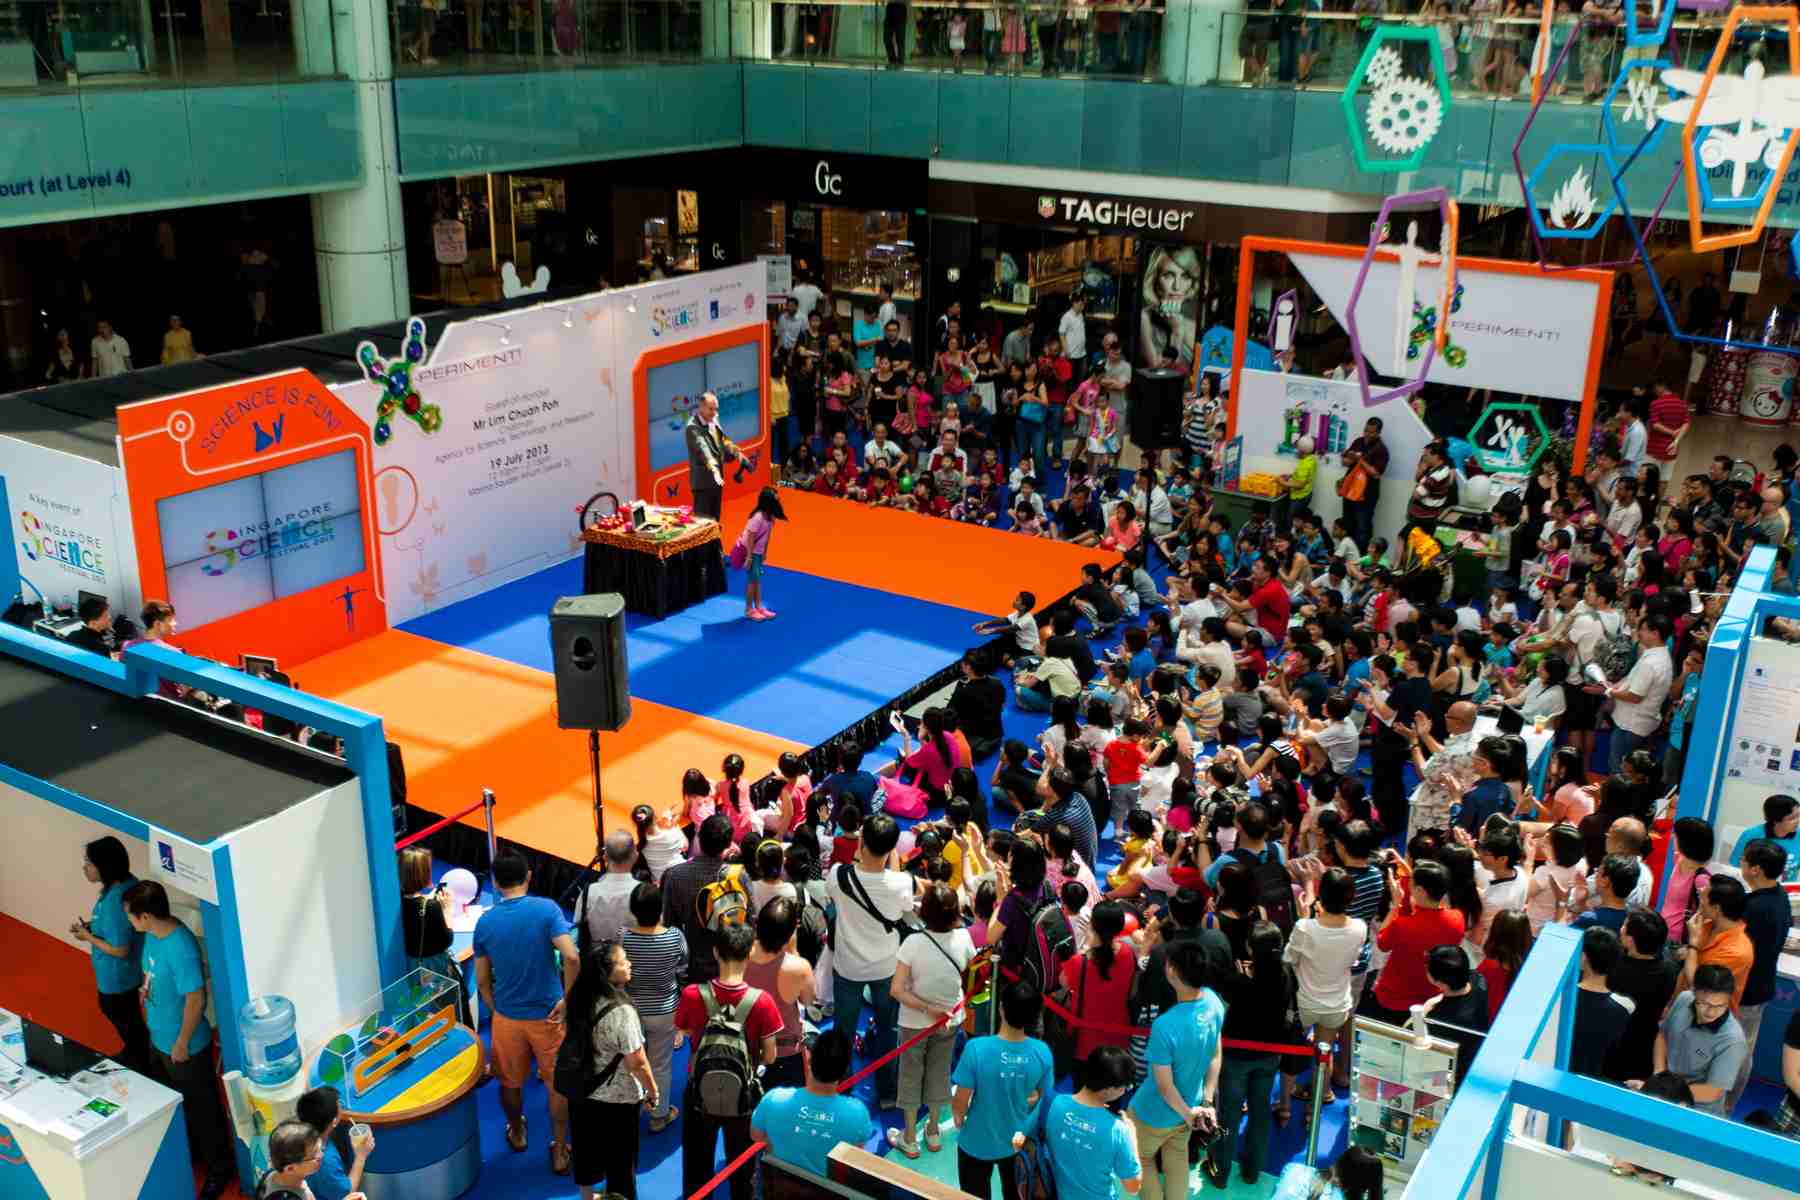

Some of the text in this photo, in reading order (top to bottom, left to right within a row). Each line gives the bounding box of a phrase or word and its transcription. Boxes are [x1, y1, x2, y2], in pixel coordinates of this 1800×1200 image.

[40, 175, 63, 197] (at
[67, 170, 111, 191] Level
[115, 167, 131, 188] 4)
[815, 160, 842, 195] Gc
[201, 385, 342, 454] SCIENCE IS FUN!
[472, 420, 486, 431] Mr
[488, 414, 506, 427] Lim
[508, 406, 540, 421] Chuan
[490, 459, 502, 469] 19
[503, 454, 523, 467] July
[526, 444, 549, 459] 2013
